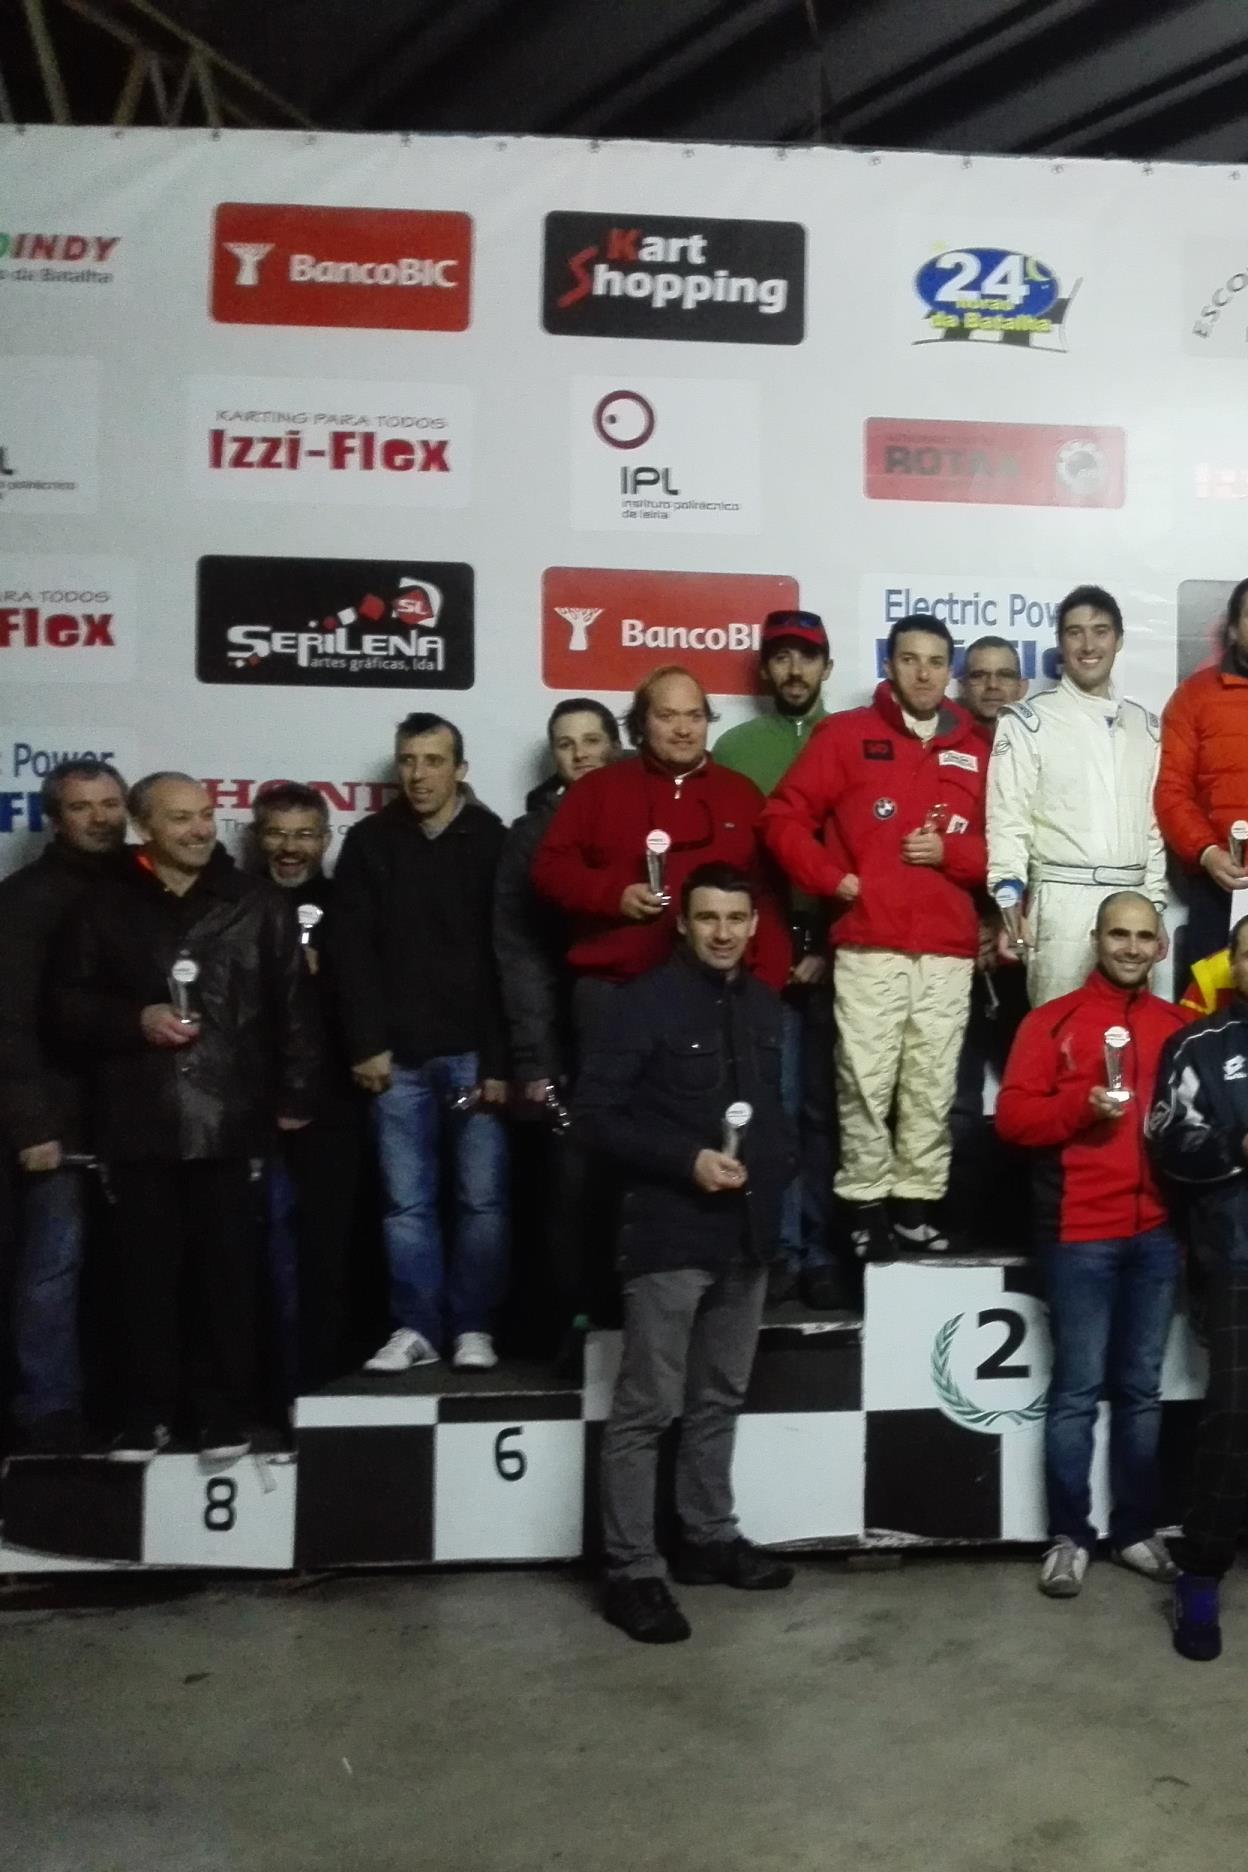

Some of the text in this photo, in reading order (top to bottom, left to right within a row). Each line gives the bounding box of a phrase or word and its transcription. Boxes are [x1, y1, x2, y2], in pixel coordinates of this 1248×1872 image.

[607, 228, 708, 264] Kart
[289, 254, 458, 287] BancoBIC
[558, 246, 788, 313] Shopping
[934, 251, 1030, 303] 24
[217, 409, 447, 430] KARTING PARA TODOS
[208, 428, 451, 472] Izzi-Flex
[621, 466, 680, 495] IPL
[40, 590, 110, 603] TODOS
[885, 588, 997, 626] Electric
[621, 619, 764, 651] BancoBI
[975, 1307, 1031, 1381] 2
[495, 1427, 527, 1481] 6
[204, 1477, 236, 1531] 8
